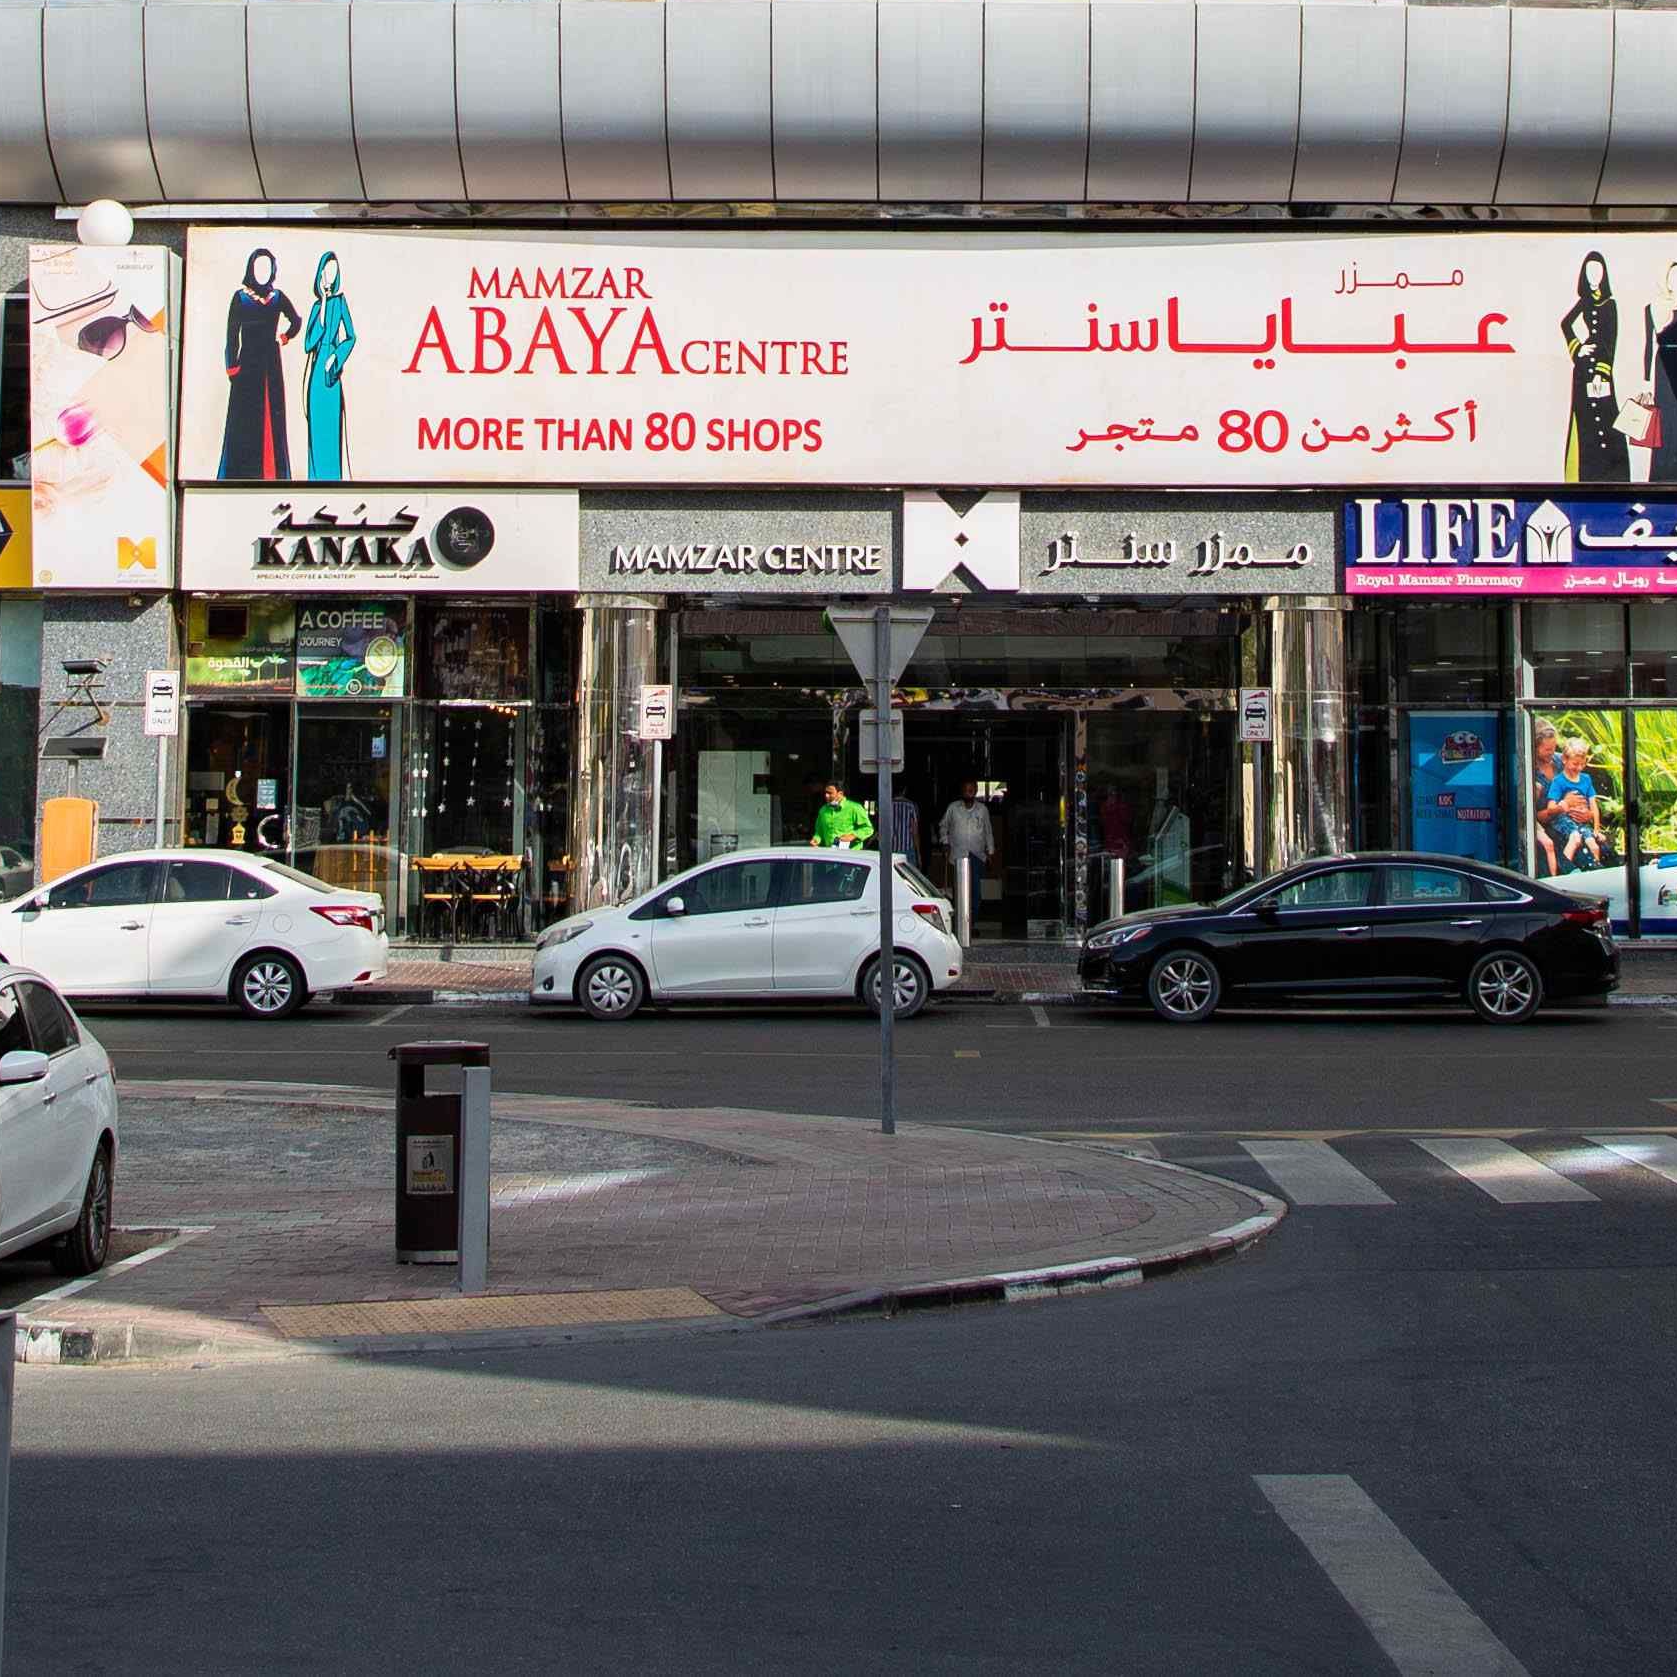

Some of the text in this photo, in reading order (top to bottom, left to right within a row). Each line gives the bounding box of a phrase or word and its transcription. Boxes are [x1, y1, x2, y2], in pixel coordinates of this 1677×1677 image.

[467, 267, 652, 299] MAMZAR
[1334, 266, 1464, 295] ممزر
[402, 307, 849, 375] ABAYA CENTRE
[418, 413, 822, 452] MORE THAN 80 SHOPS
[1066, 420, 1199, 453] متجر
[1217, 409, 1289, 453] 80
[276, 503, 420, 531] كنكة
[1356, 499, 1520, 563] LIFE
[257, 537, 435, 565] KANAKA
[614, 545, 882, 571] MAMZAR CENTRE
[1047, 534, 1312, 573] ممزر سنتر
[1356, 574, 1523, 589] Royal Mamzar Pharmacy
[1564, 575, 1606, 589] ممزر
[1612, 572, 1650, 588] رويال
[300, 611, 384, 629] A COFFEE
[300, 636, 343, 648] JOURNEY
